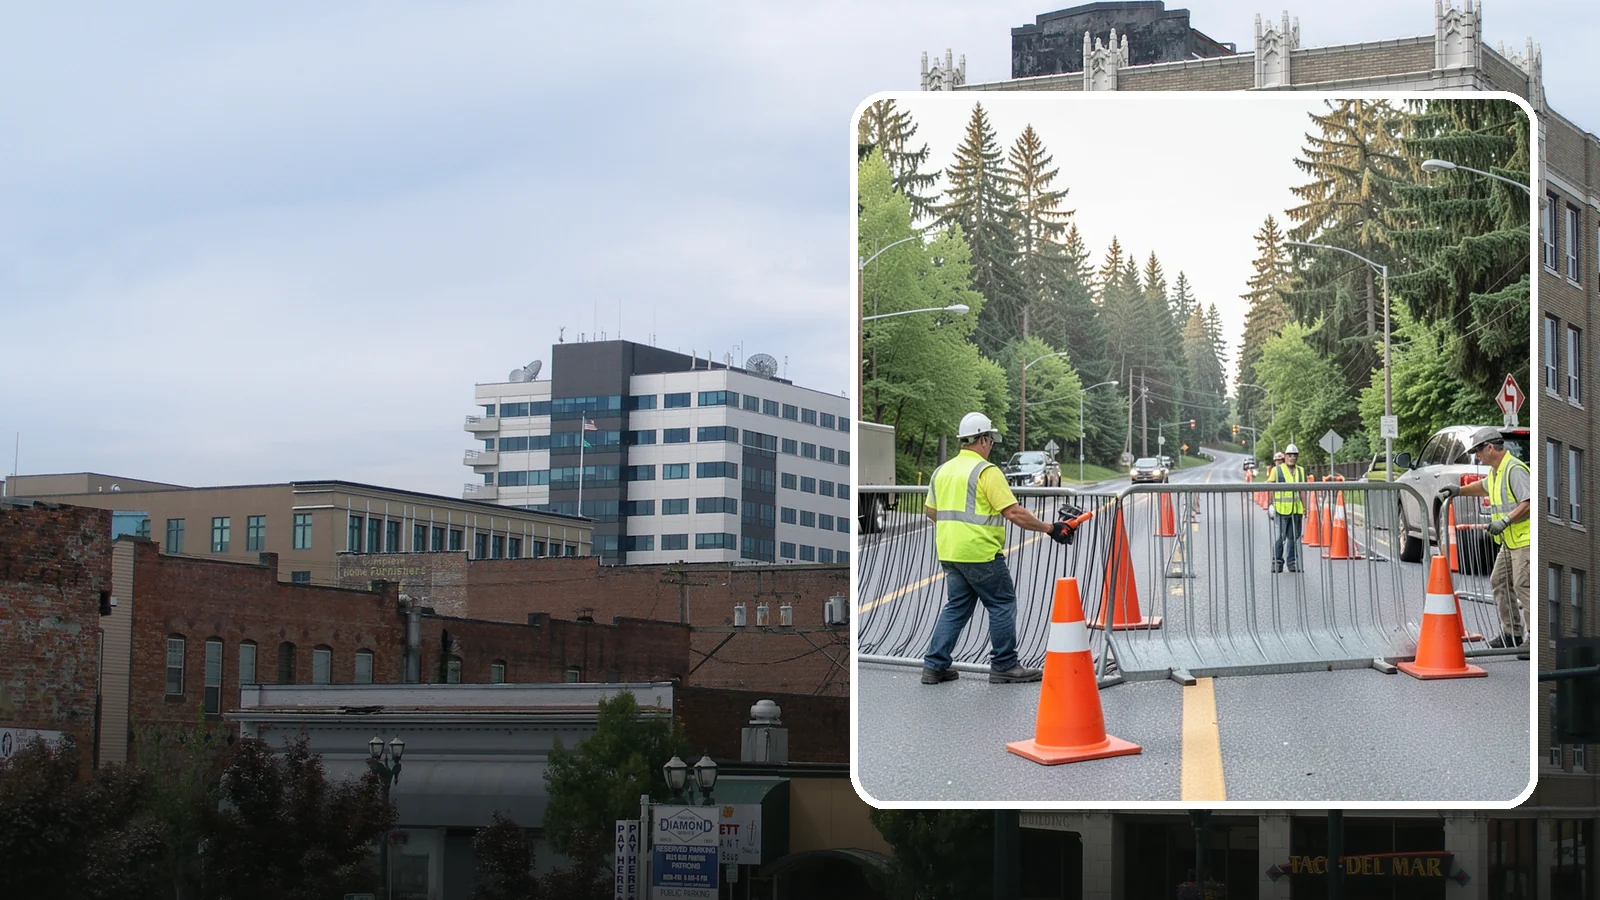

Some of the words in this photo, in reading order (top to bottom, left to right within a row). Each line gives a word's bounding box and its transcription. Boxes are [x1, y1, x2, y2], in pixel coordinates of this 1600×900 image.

[660, 818, 713, 832] DIAMOND
[1022, 815, 1070, 828] BUILDING
[719, 824, 740, 835] ETT
[617, 825, 625, 852] PAY
[628, 825, 637, 852] PAY
[719, 839, 740, 848] ANT
[656, 845, 687, 853] RESERVED
[721, 851, 739, 863] Soup
[1288, 855, 1329, 874] TAC
[1345, 855, 1385, 876] DEL
[1392, 857, 1443, 877] MAR
[617, 856, 625, 893] HERE
[628, 856, 636, 893] HERE
[660, 888, 682, 897] PUBLIC
[684, 889, 710, 898] PARKING
